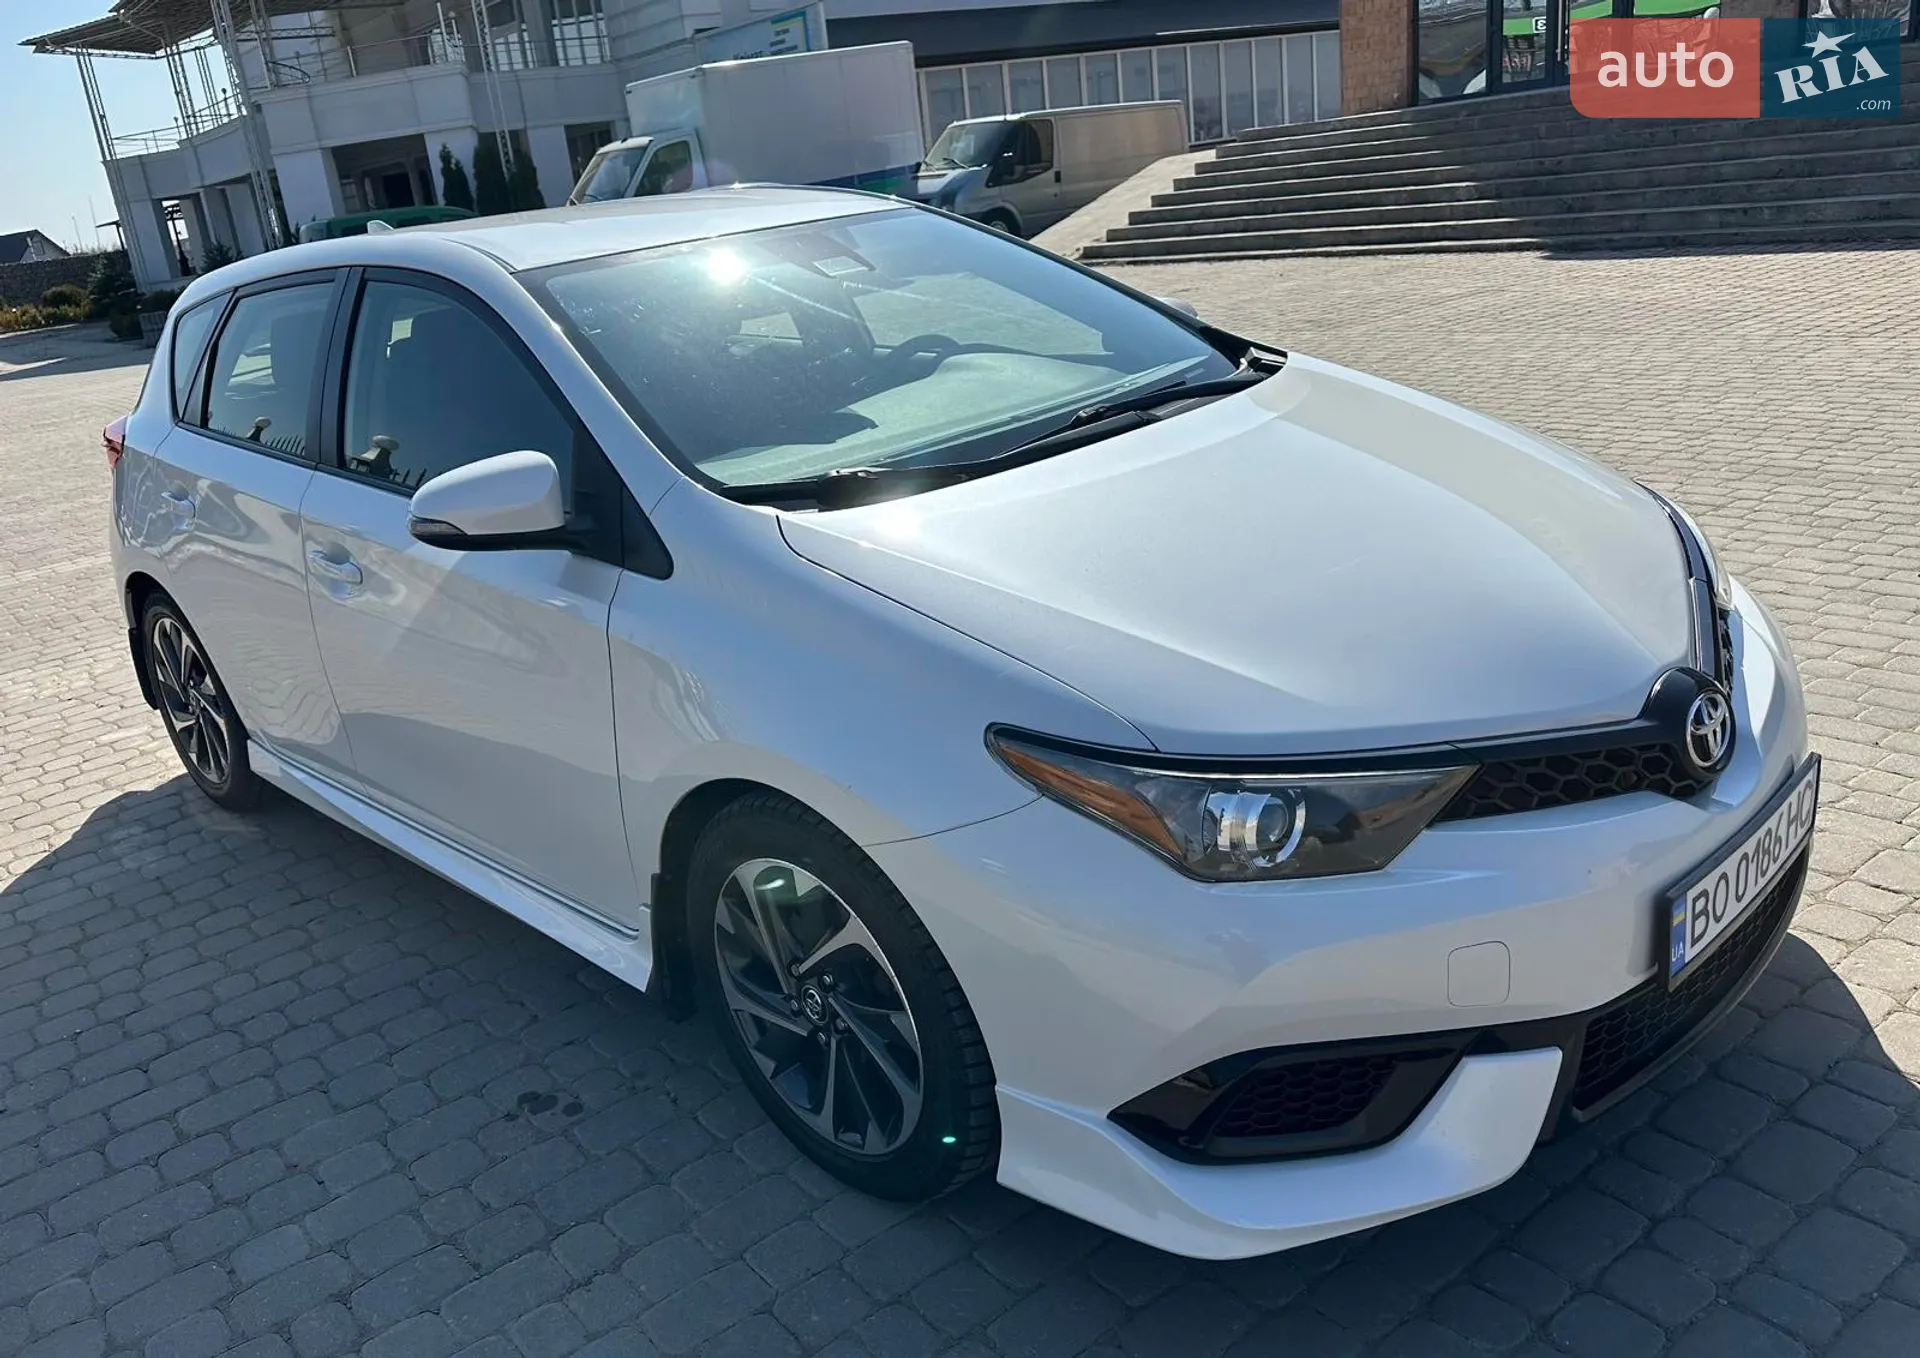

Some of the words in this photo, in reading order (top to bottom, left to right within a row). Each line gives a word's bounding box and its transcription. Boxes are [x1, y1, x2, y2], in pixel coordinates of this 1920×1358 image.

[1691, 872, 1730, 948] BO
[1735, 811, 1784, 903] 0186
[1671, 942, 1684, 962] UA
